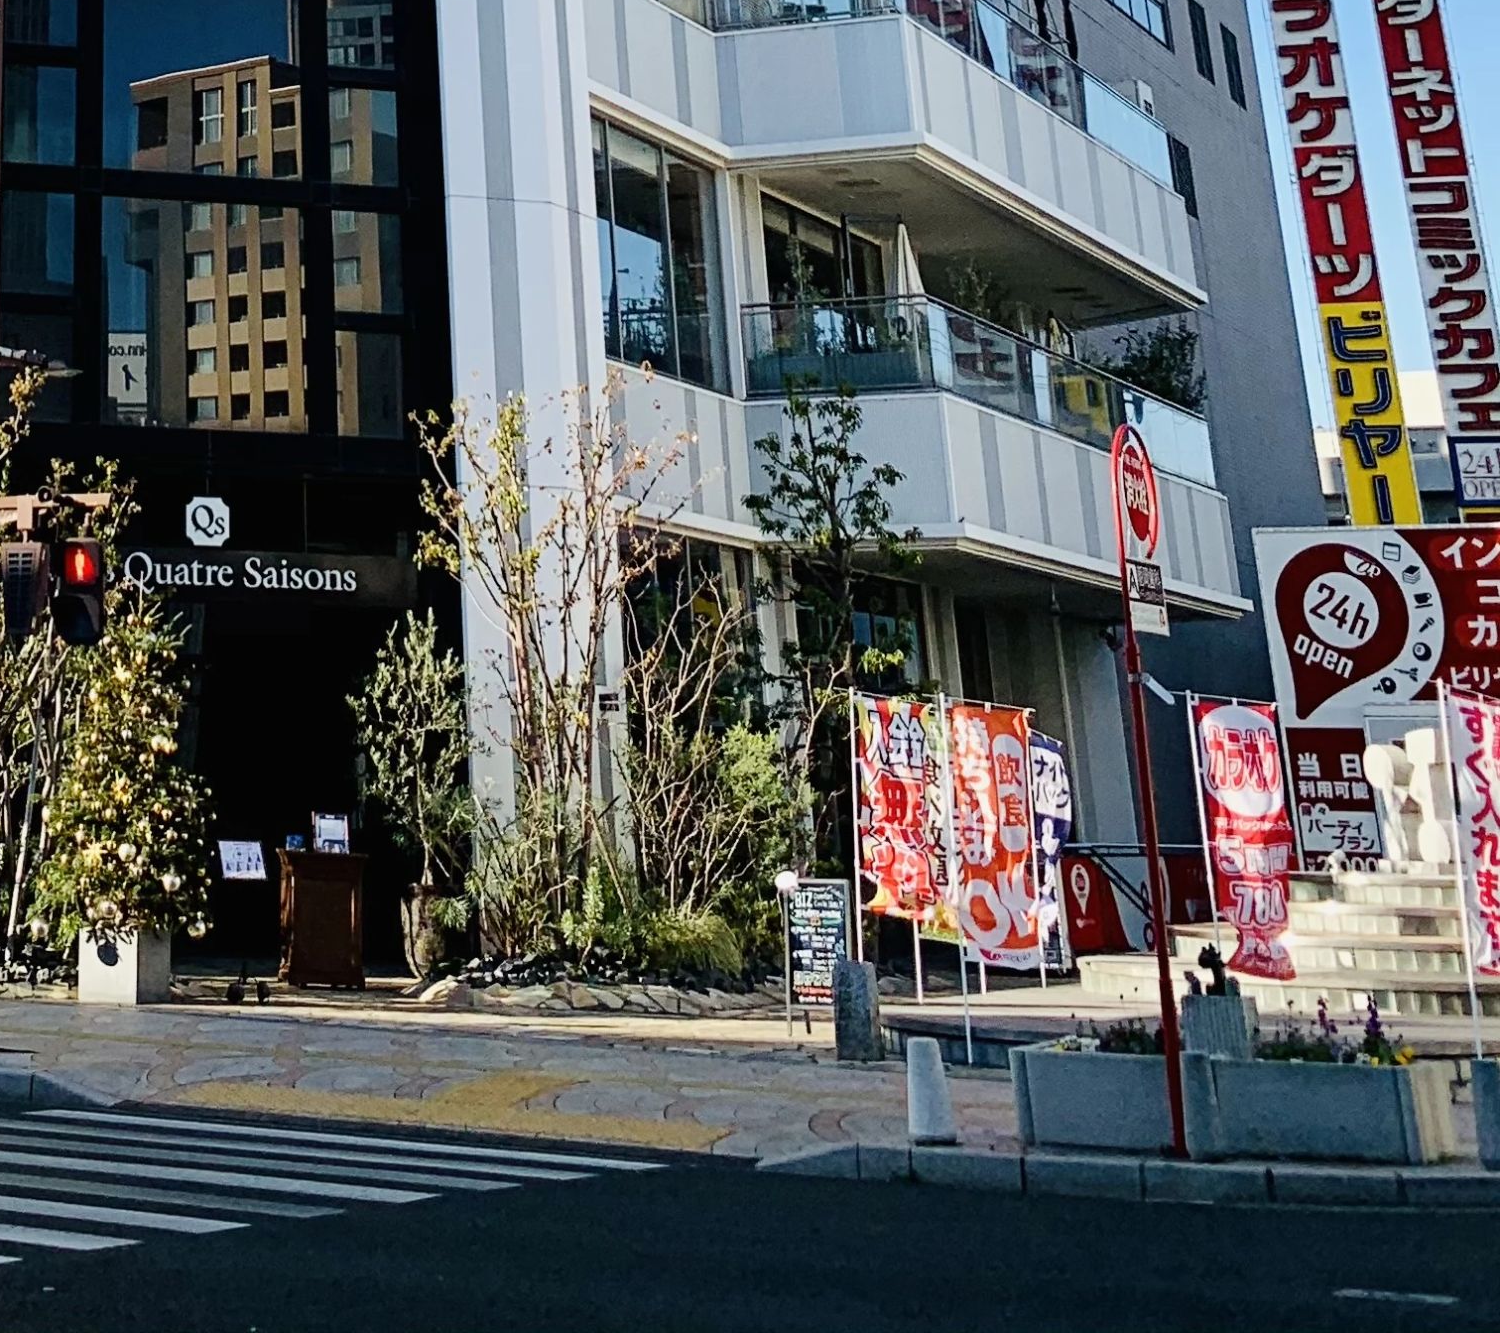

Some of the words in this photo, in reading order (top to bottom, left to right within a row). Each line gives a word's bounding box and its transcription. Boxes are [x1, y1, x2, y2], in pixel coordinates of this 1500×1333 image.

[1301, 149, 1374, 297] ダーツ
[1409, 181, 1500, 431] コミックカフェ
[190, 504, 225, 538] Qs
[124, 551, 234, 594] Quatre
[243, 556, 357, 592] Saisons
[1309, 583, 1370, 639] 24h
[1293, 633, 1354, 679] open
[1298, 752, 1362, 779] 当日
[996, 752, 1026, 828] 飲食
[1298, 780, 1370, 800] 利用可能
[1308, 819, 1363, 835] パーティ
[959, 863, 1037, 949] OK
